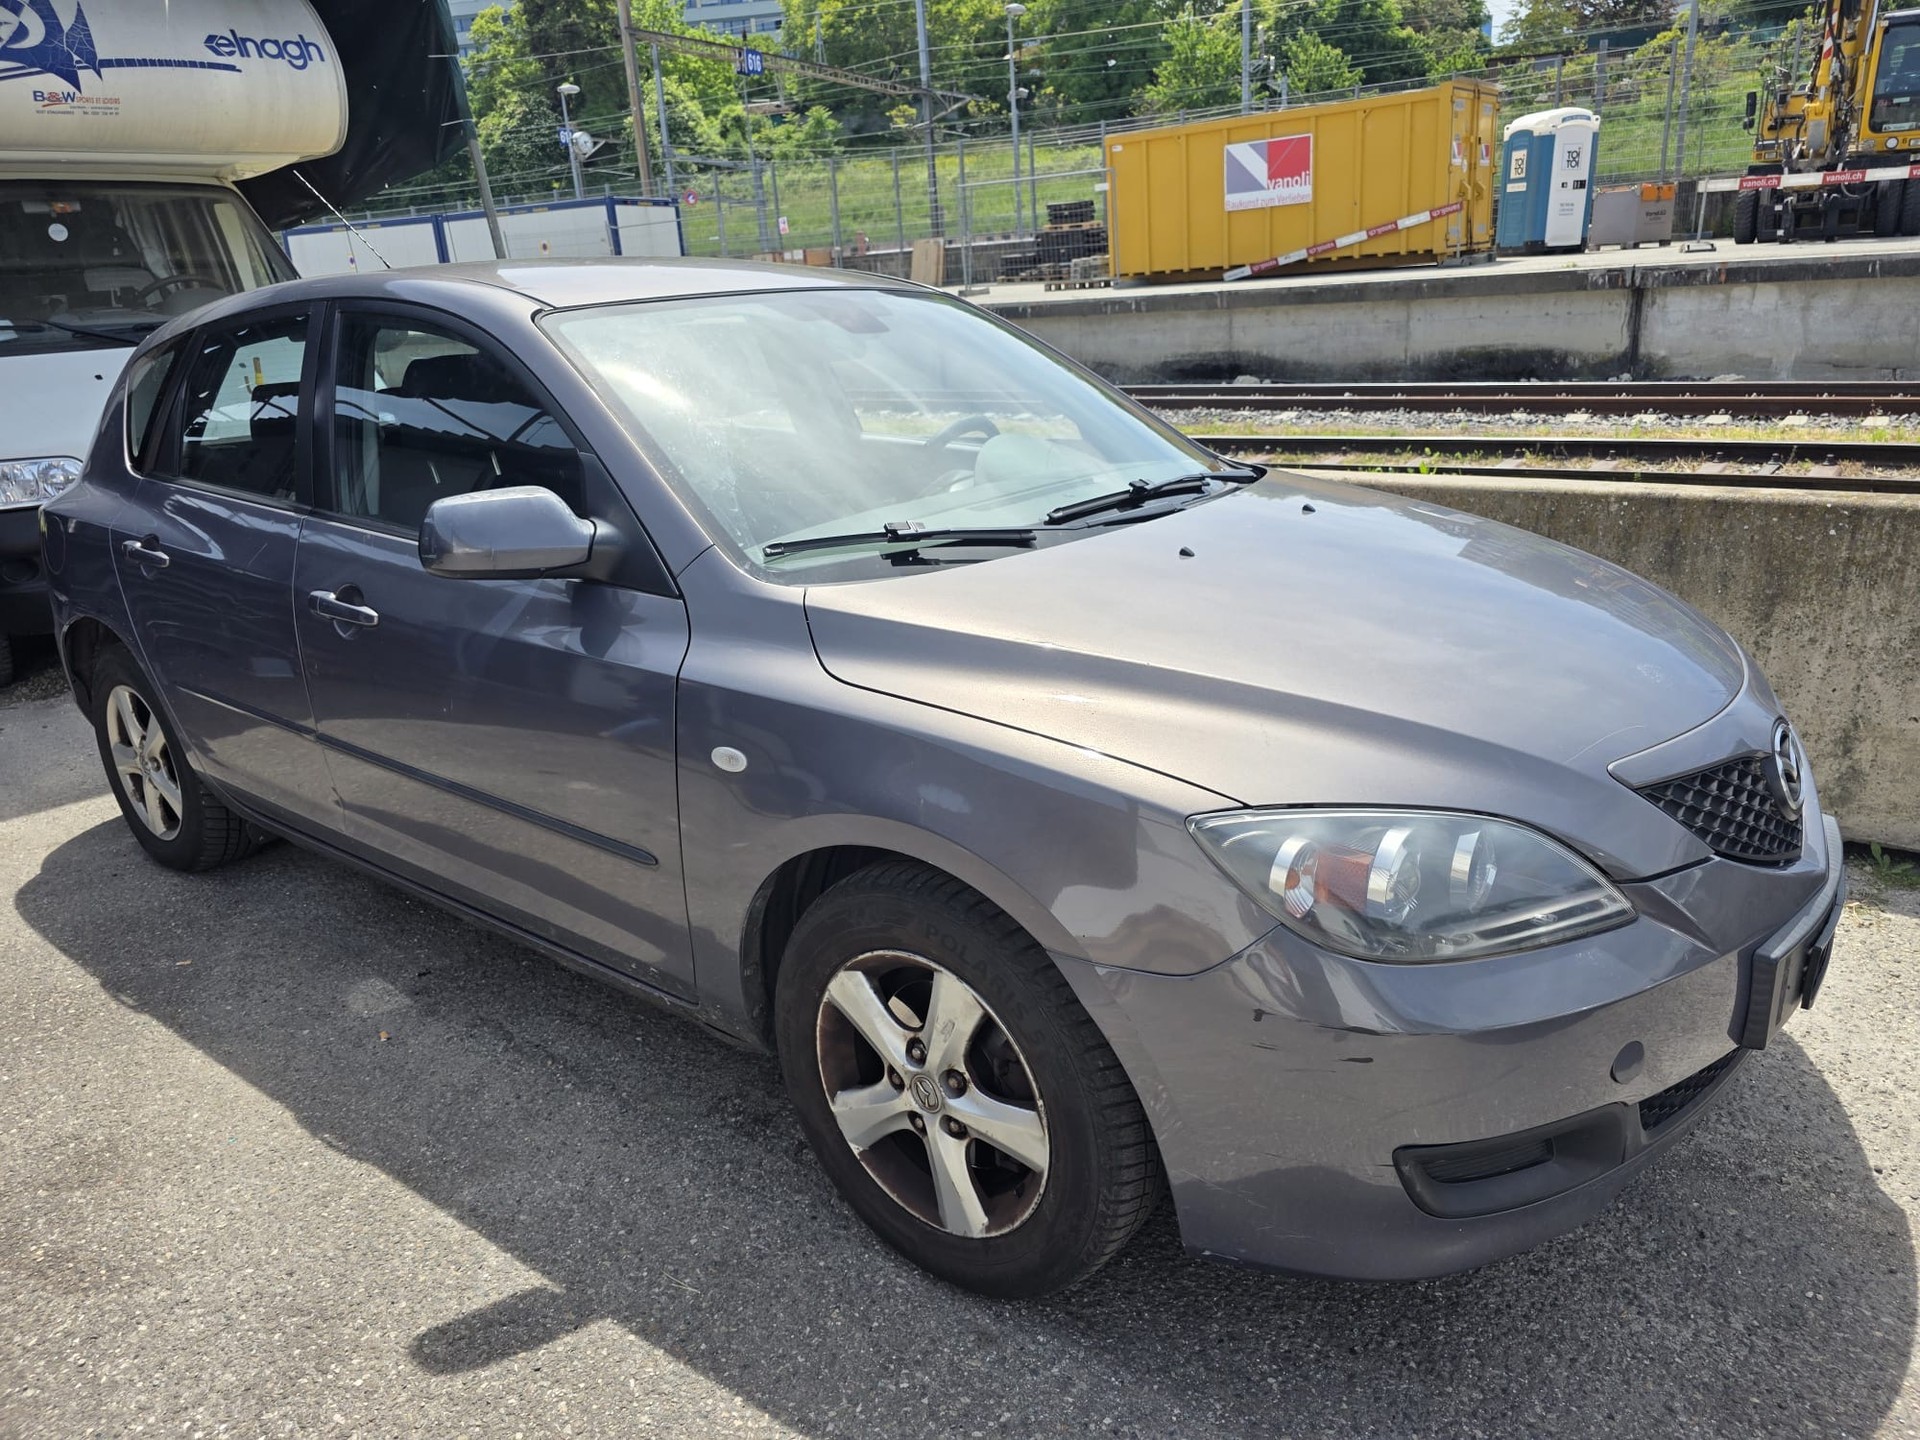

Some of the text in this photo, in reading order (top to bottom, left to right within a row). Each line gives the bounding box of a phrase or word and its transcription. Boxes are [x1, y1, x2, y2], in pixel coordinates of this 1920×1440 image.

[212, 29, 325, 70] elnagh
[747, 53, 762, 72] 616
[33, 90, 75, 103] B&W
[1267, 171, 1310, 190] vanoli
[1742, 176, 1778, 187] vanoli.ch
[1826, 172, 1863, 182] vanoli.ch
